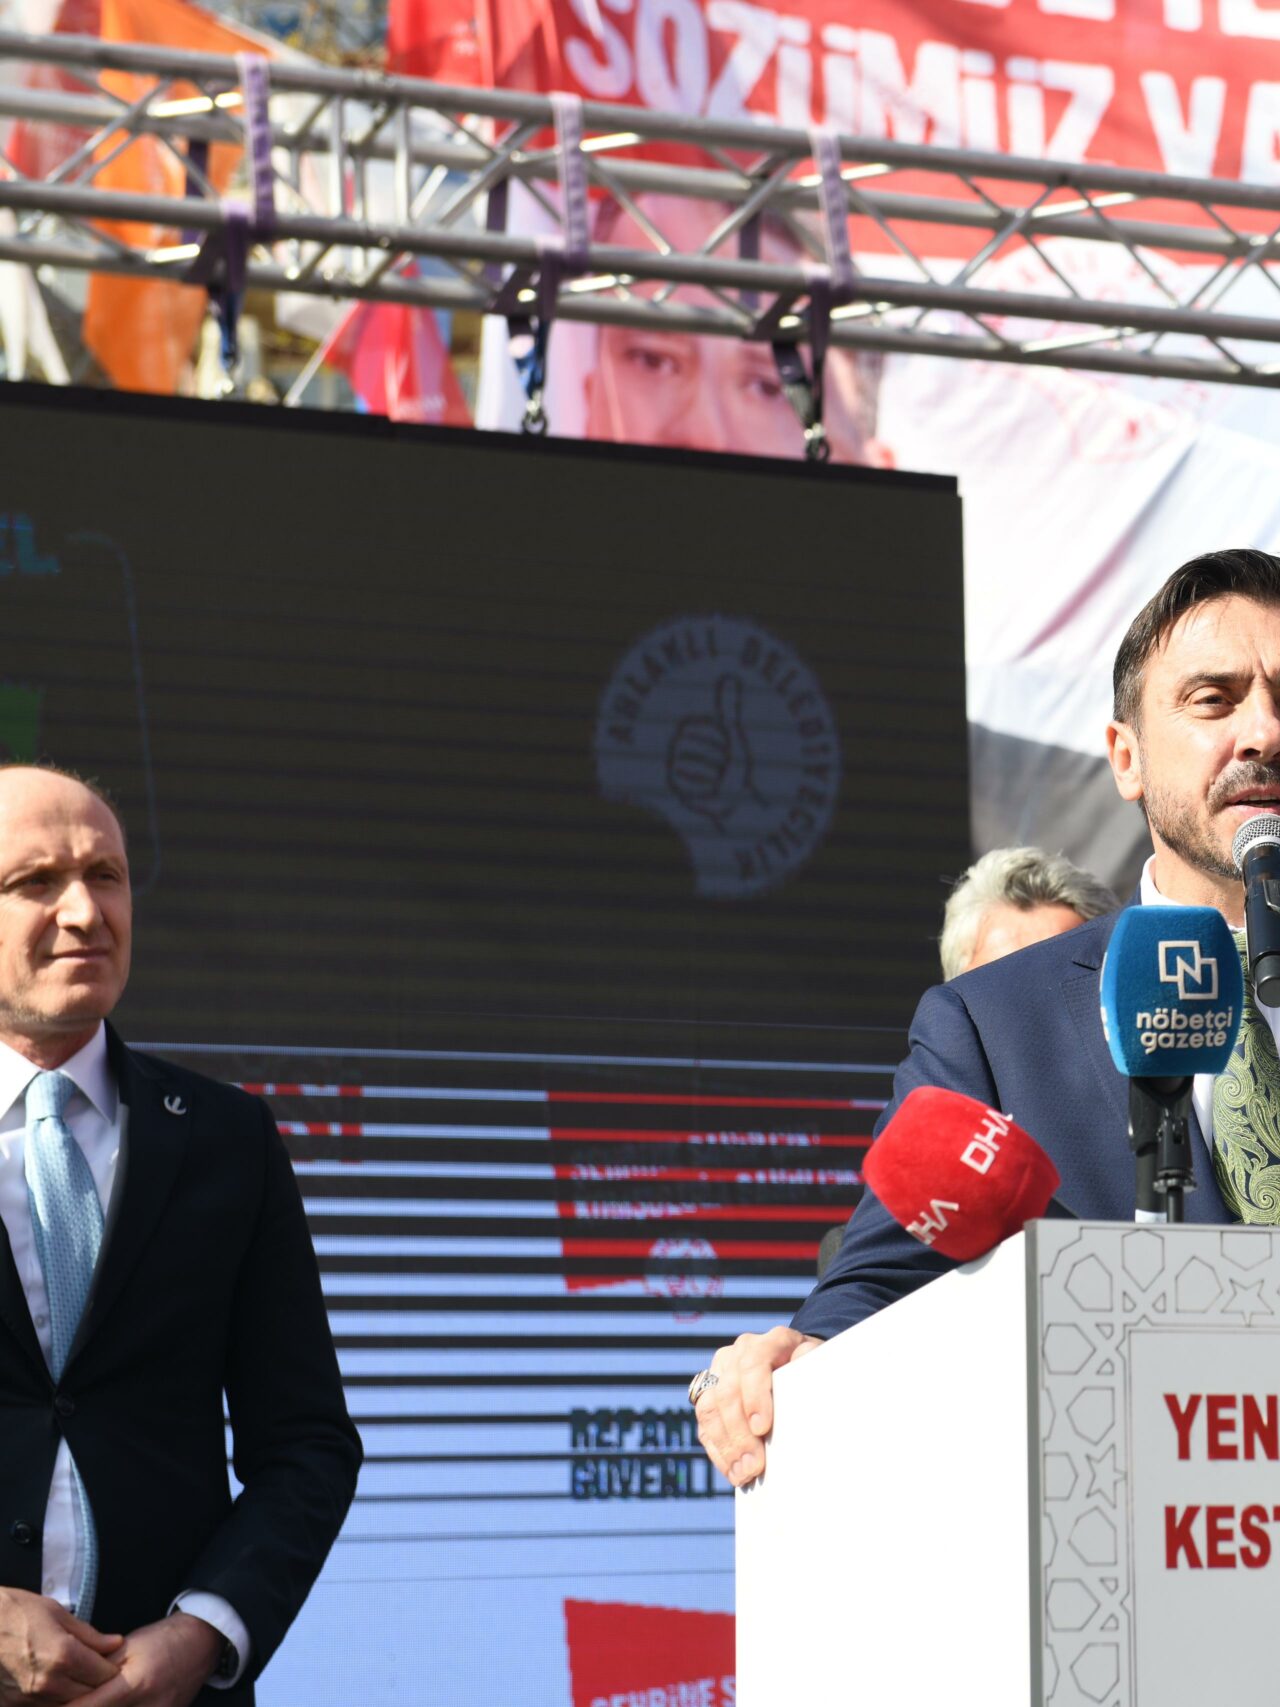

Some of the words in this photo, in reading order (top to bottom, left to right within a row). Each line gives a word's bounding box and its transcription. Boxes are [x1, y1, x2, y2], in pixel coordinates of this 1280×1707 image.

[1136, 1006, 1233, 1031] nöbetçi
[1140, 1029, 1227, 1055] gazete
[959, 1109, 1014, 1175] DHA
